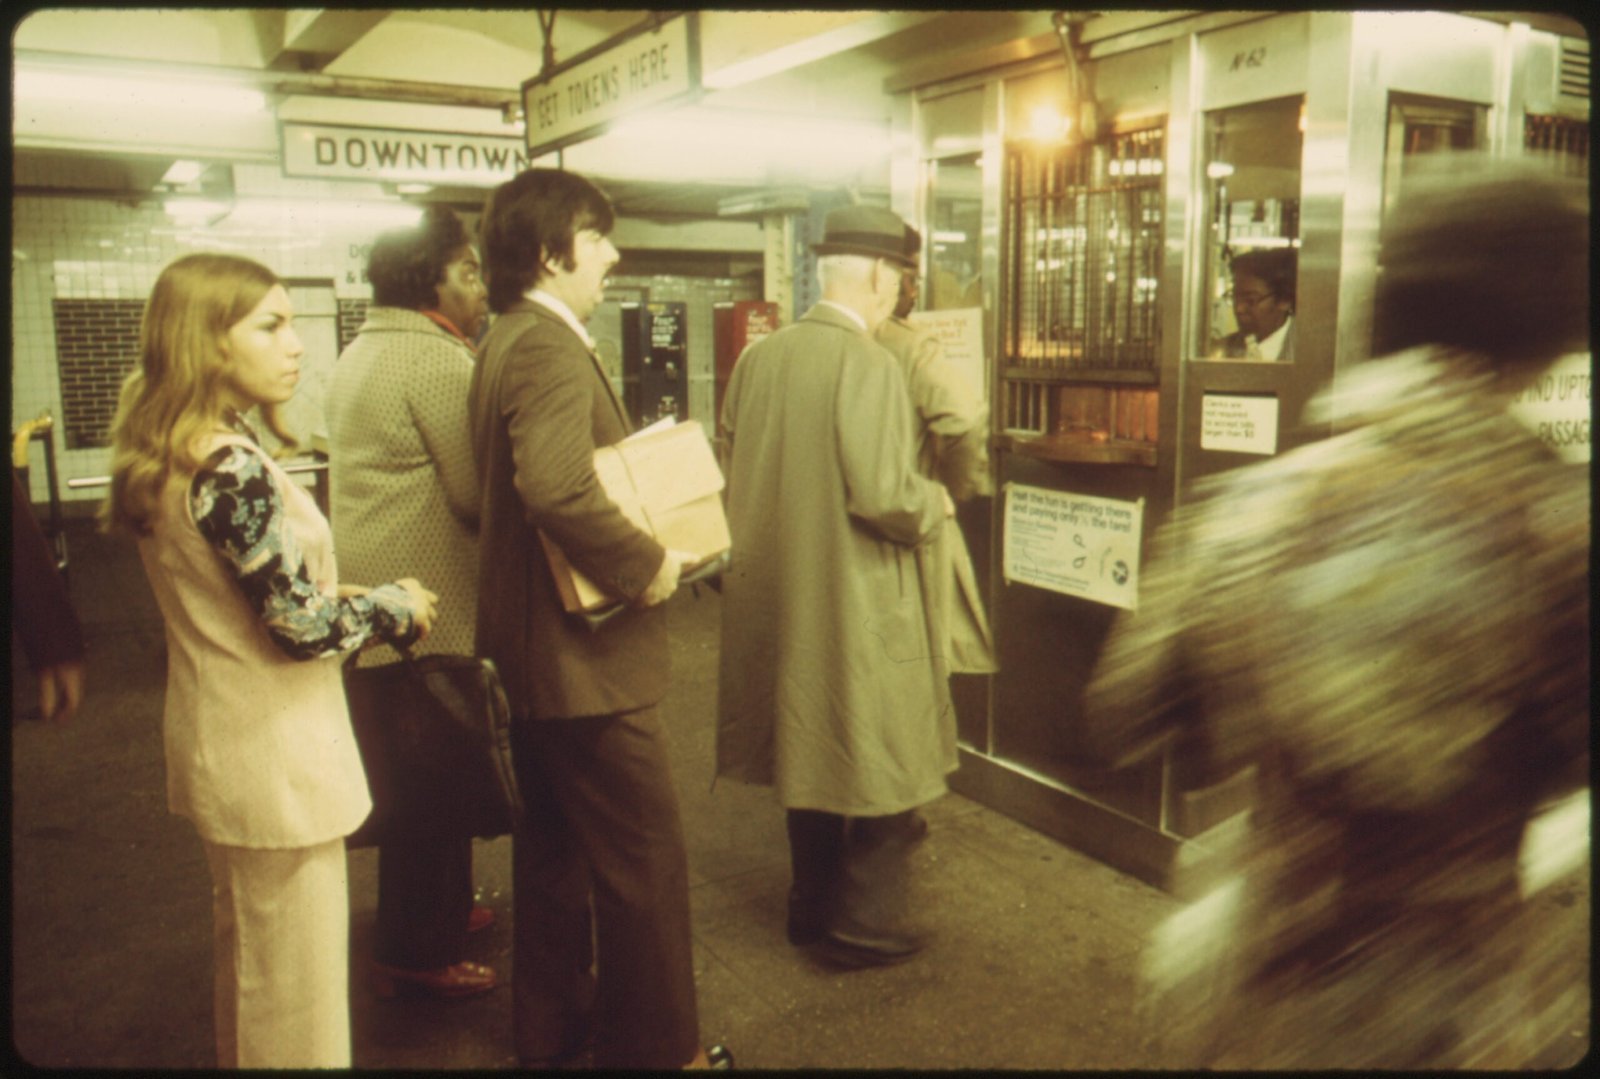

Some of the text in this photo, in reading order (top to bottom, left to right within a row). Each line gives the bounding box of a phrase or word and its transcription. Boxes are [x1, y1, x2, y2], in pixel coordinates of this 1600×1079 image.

[538, 43, 670, 130] GET TOKENS HERE
[315, 136, 529, 171] DOWNTOWN
[1218, 410, 1249, 420] required
[1012, 490, 1132, 520] Half the fun is getting there
[1012, 503, 1028, 515] and
[1029, 507, 1058, 522] paying
[1060, 512, 1078, 527] only
[1091, 515, 1107, 529] the
